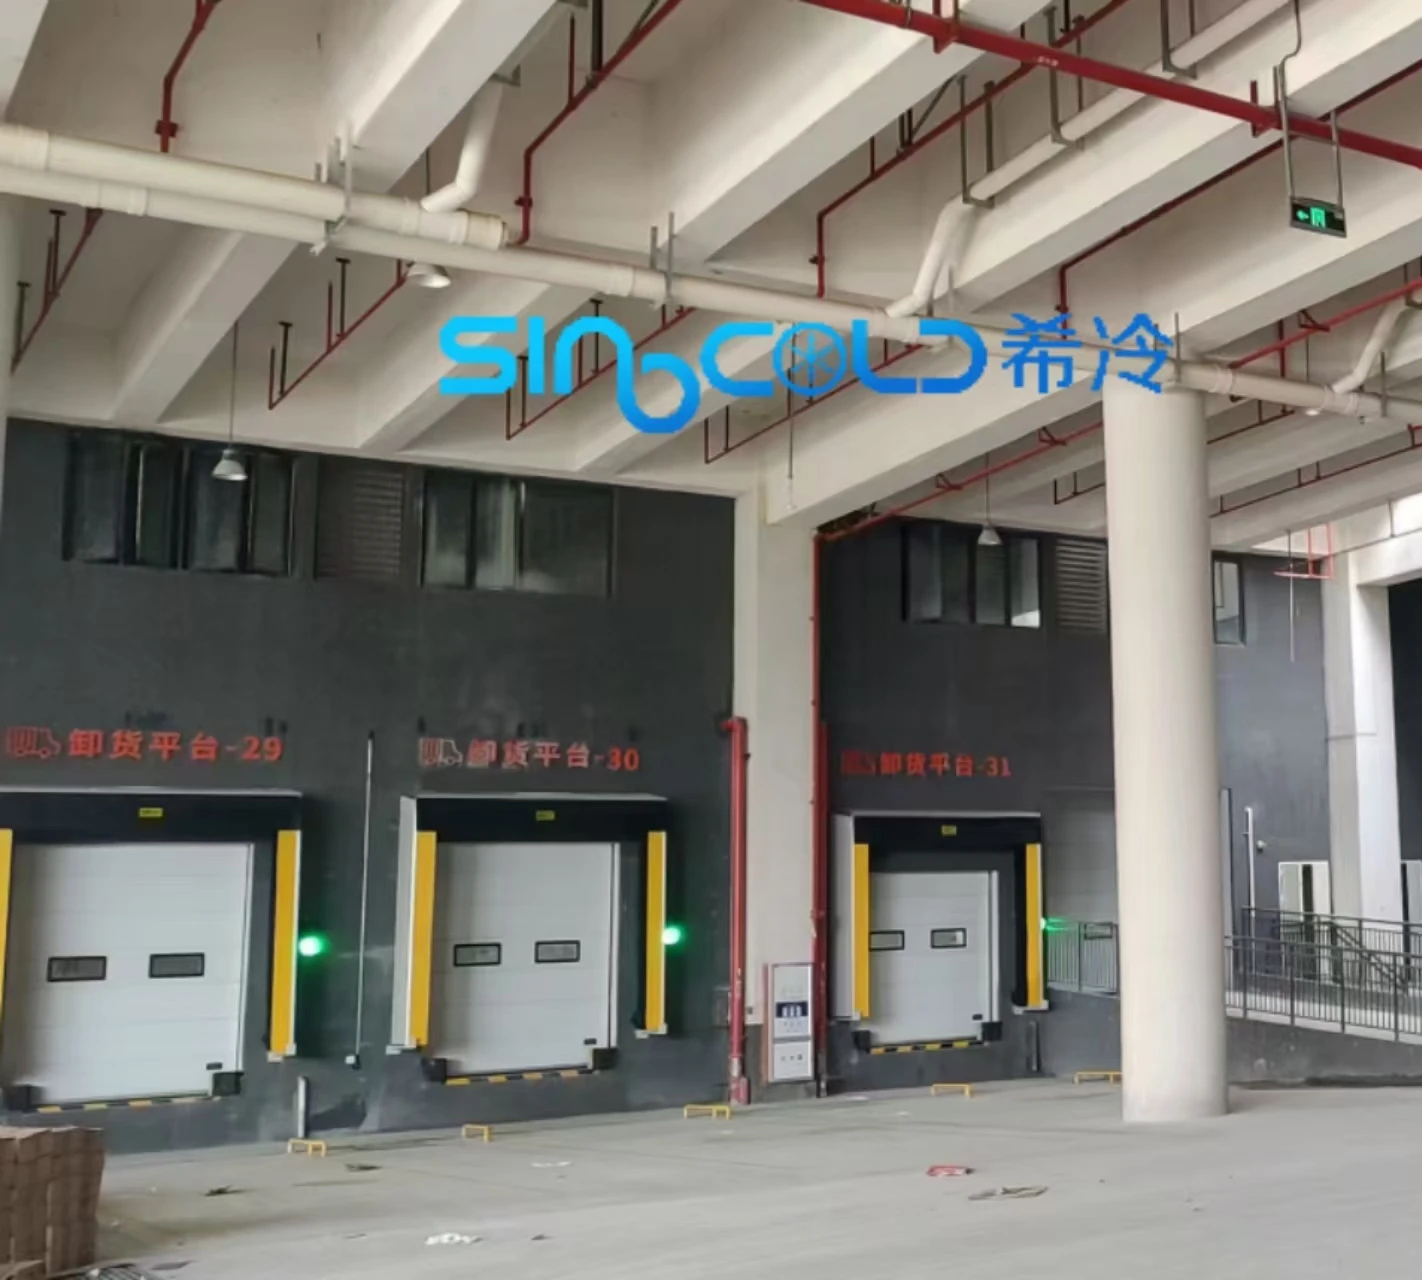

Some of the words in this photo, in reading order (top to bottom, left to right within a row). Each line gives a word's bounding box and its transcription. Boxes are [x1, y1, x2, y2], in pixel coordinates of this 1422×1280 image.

[67, 728, 283, 761] 卸货平台-29
[466, 738, 640, 771] 卸货平台-30
[879, 751, 1012, 777] 卸货平台-31
